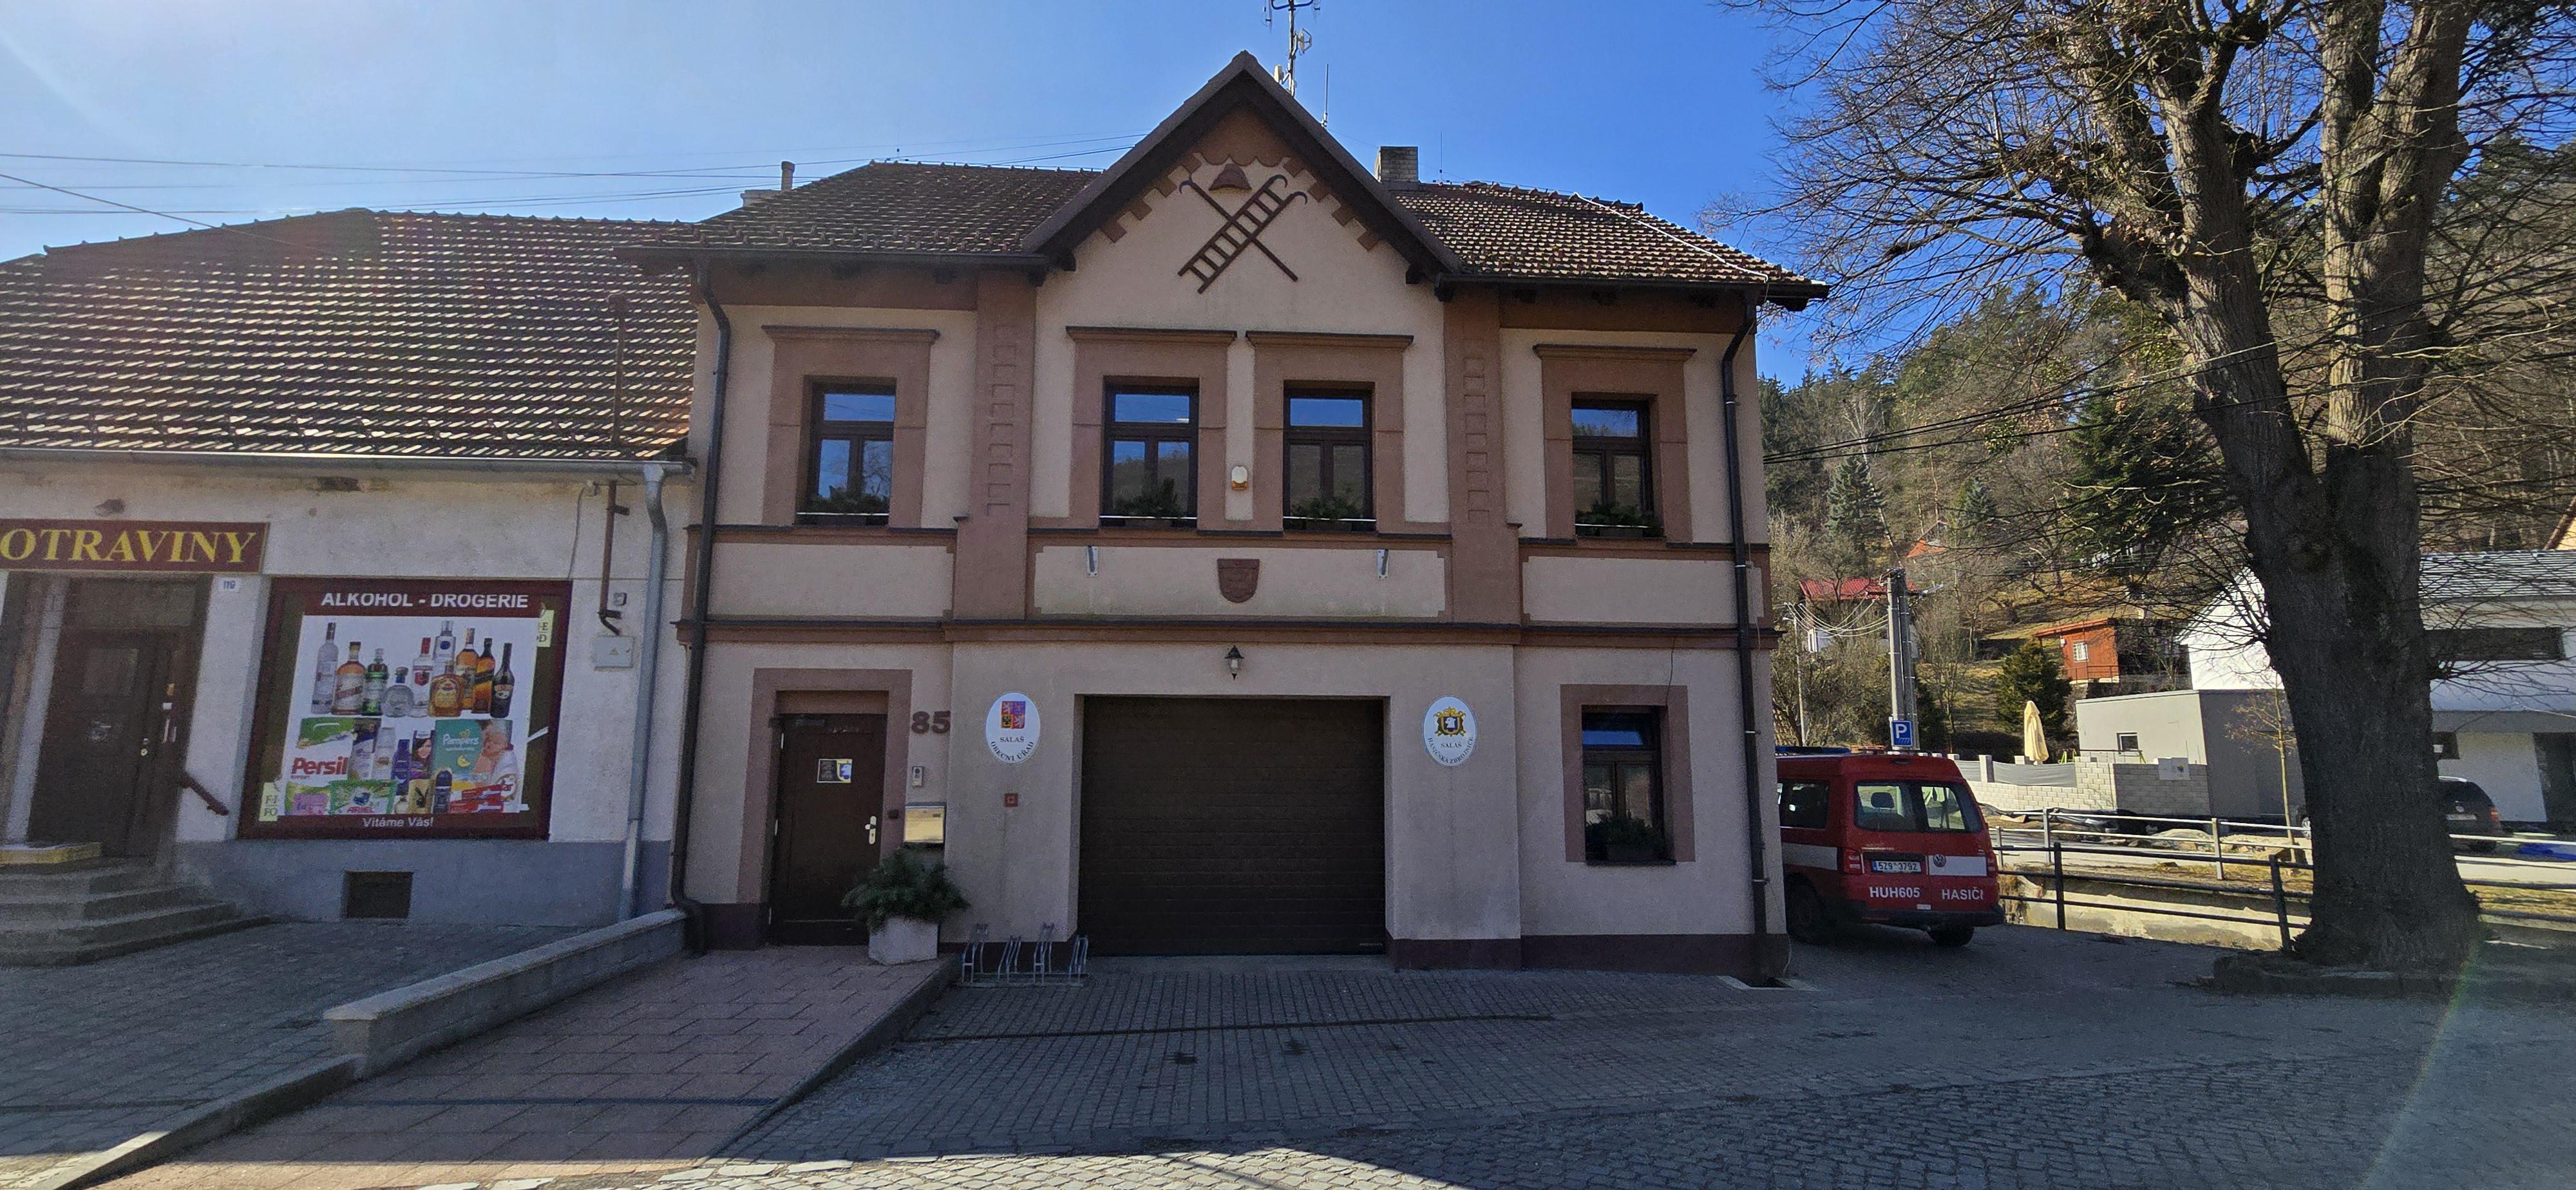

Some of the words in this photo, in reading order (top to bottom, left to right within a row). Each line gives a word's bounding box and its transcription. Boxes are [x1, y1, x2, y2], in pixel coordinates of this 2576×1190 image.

[1, 528, 257, 563] OTRAVINY
[321, 592, 413, 607] ALKOHOL
[430, 594, 529, 608] DROGERIE
[911, 710, 951, 734] 85
[1895, 723, 1908, 739] P
[292, 756, 349, 775] Persil
[363, 817, 404, 827] Vitáme
[408, 817, 434, 827] Vás!
[1869, 886, 1920, 898] HUH605
[1942, 886, 1984, 900] HASIČI
